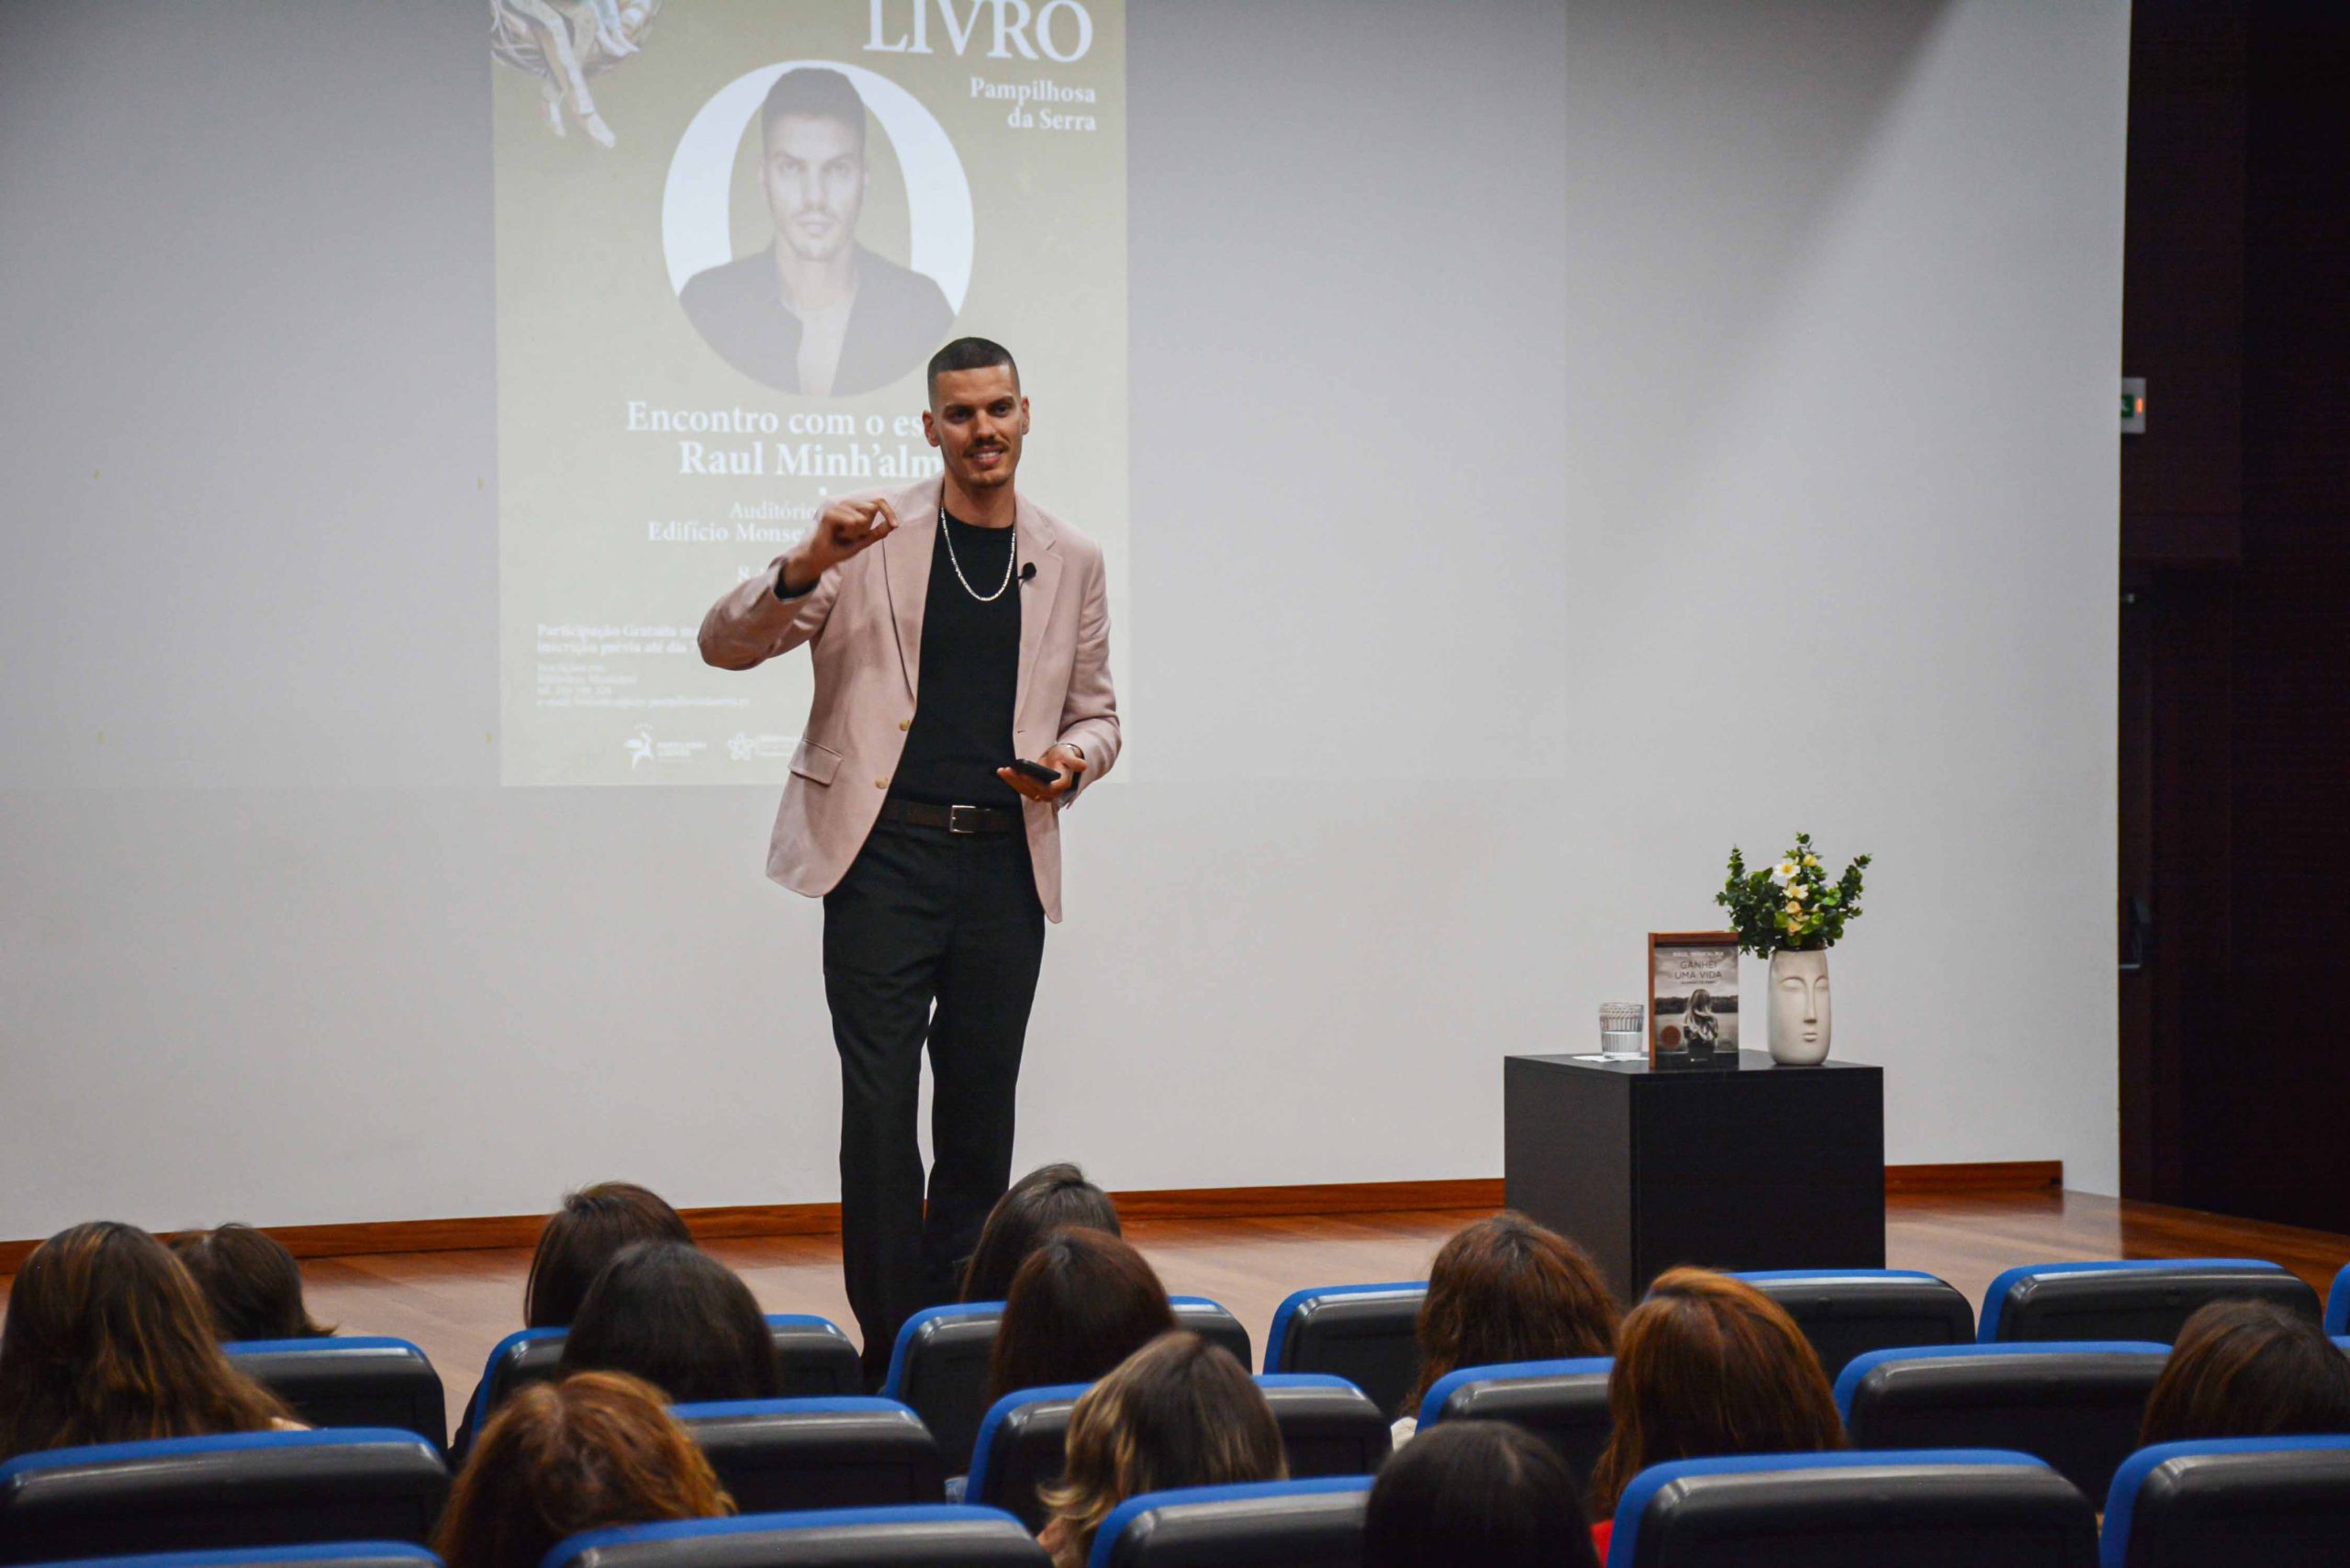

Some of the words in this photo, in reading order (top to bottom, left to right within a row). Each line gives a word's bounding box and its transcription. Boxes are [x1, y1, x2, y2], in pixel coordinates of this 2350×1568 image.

[863, 0, 1093, 62] LIVRO
[970, 77, 1096, 106] Pampilhosa
[1007, 107, 1034, 129] da
[1040, 108, 1097, 131] Serra
[626, 400, 779, 432] Encontro
[789, 413, 856, 435] com
[866, 415, 885, 436] o
[893, 415, 924, 437] es
[678, 441, 764, 476] Raul
[776, 443, 943, 477] Minh'alm
[729, 499, 817, 520] Auditório
[647, 520, 730, 542] Edifício
[735, 521, 805, 543] Monse
[1674, 971, 1696, 980] UMA
[1700, 970, 1723, 979] VIDA
